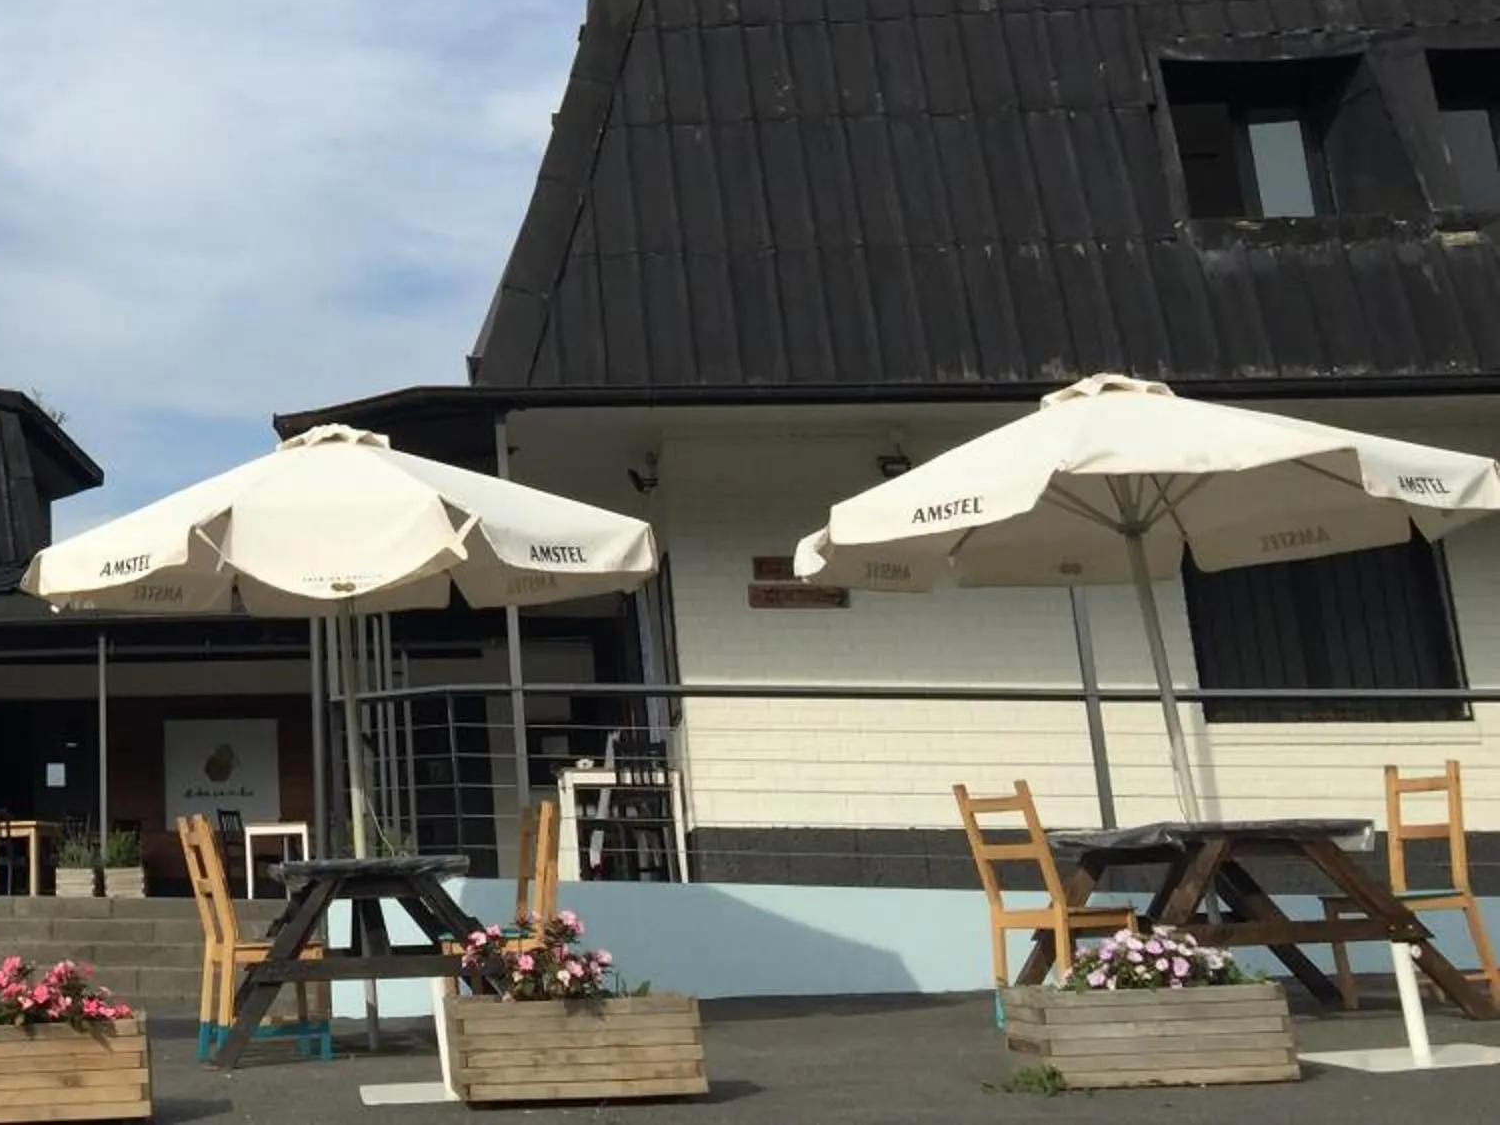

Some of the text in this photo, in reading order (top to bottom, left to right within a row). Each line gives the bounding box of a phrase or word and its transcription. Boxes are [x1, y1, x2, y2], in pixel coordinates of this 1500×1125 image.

[1398, 475, 1451, 495] AMSTEL
[911, 496, 984, 524] AMSTEL
[530, 545, 587, 563] AMSTEL
[100, 554, 152, 576] AMSTEL
